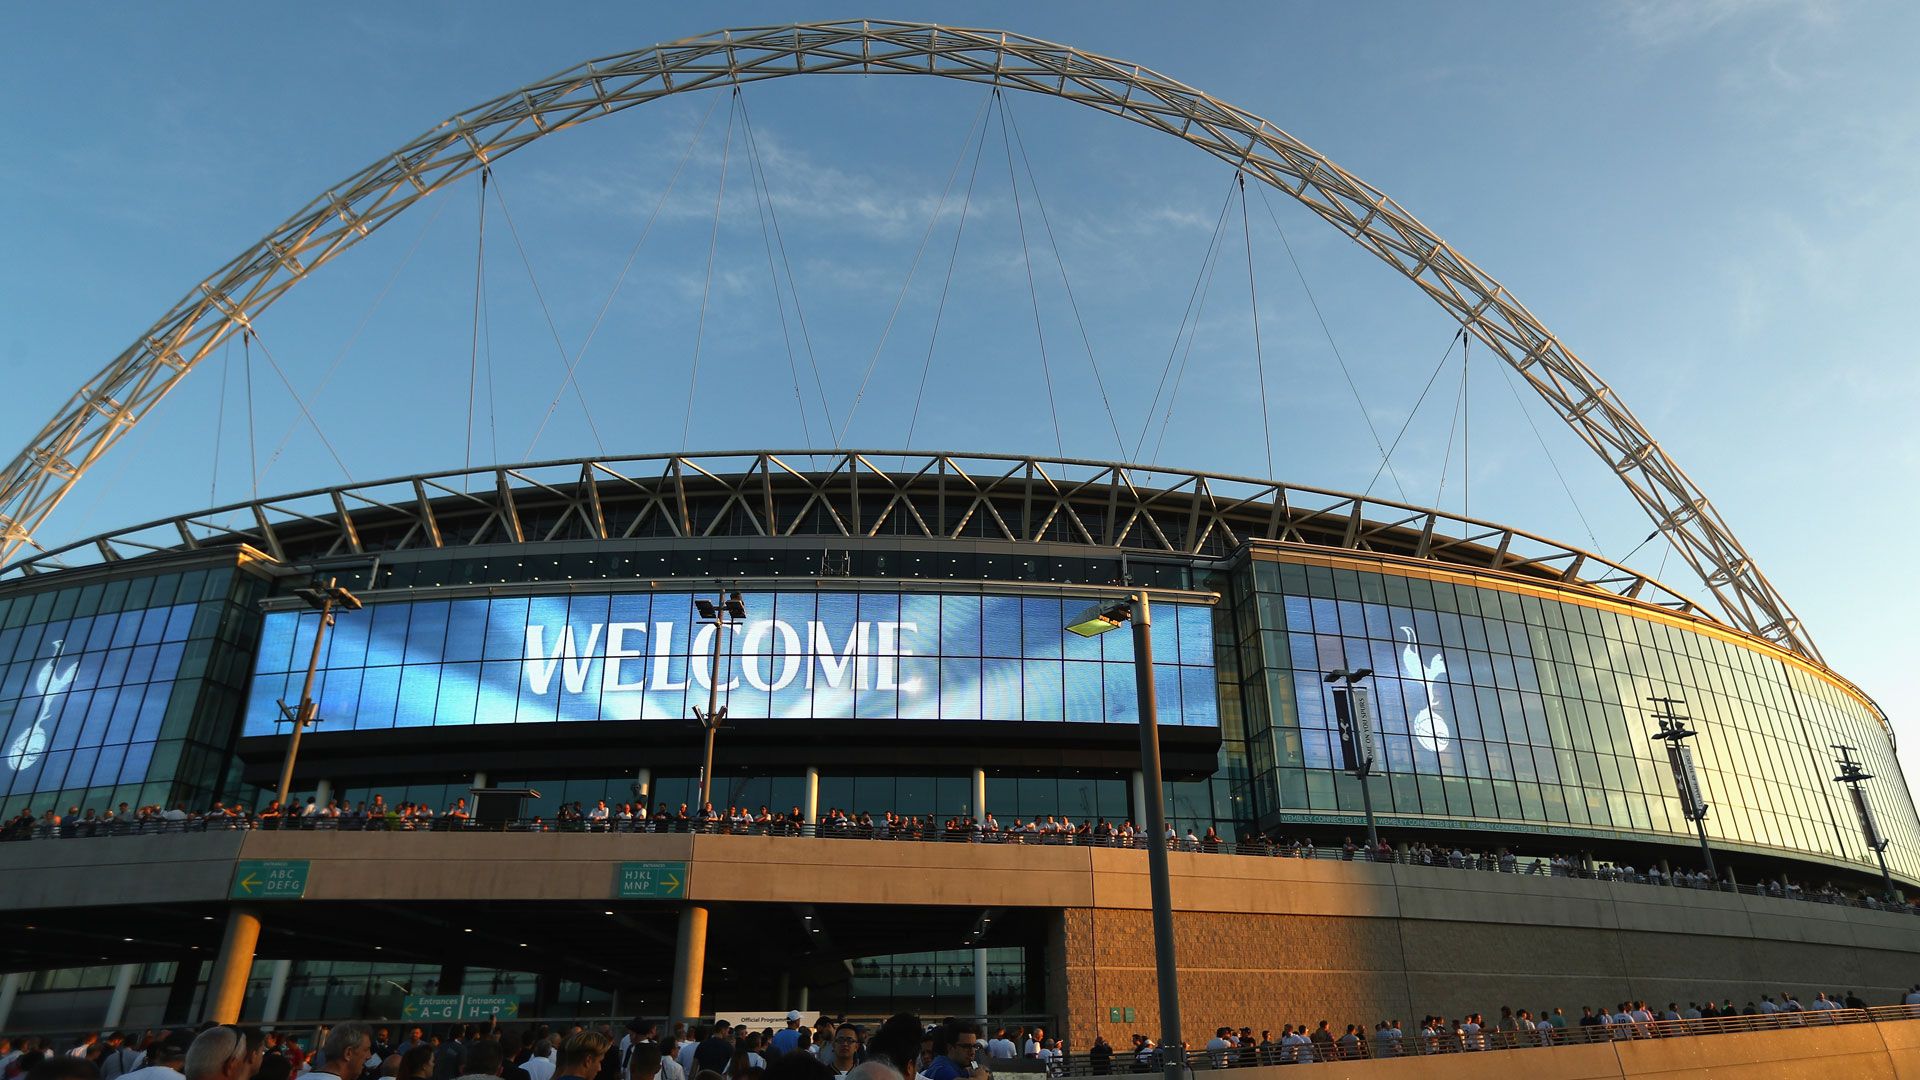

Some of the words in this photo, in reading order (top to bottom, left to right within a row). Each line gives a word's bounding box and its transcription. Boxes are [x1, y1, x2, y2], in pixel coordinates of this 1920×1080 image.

[525, 619, 918, 695] WELCOME
[1359, 697, 1367, 718] SPURS
[1281, 814, 1313, 822] WEMBLEY
[270, 869, 295, 879] ABC
[625, 871, 652, 880] HJKL
[267, 880, 300, 890] DEFG
[624, 881, 650, 890] MNP
[467, 997, 505, 1005] Entrances
